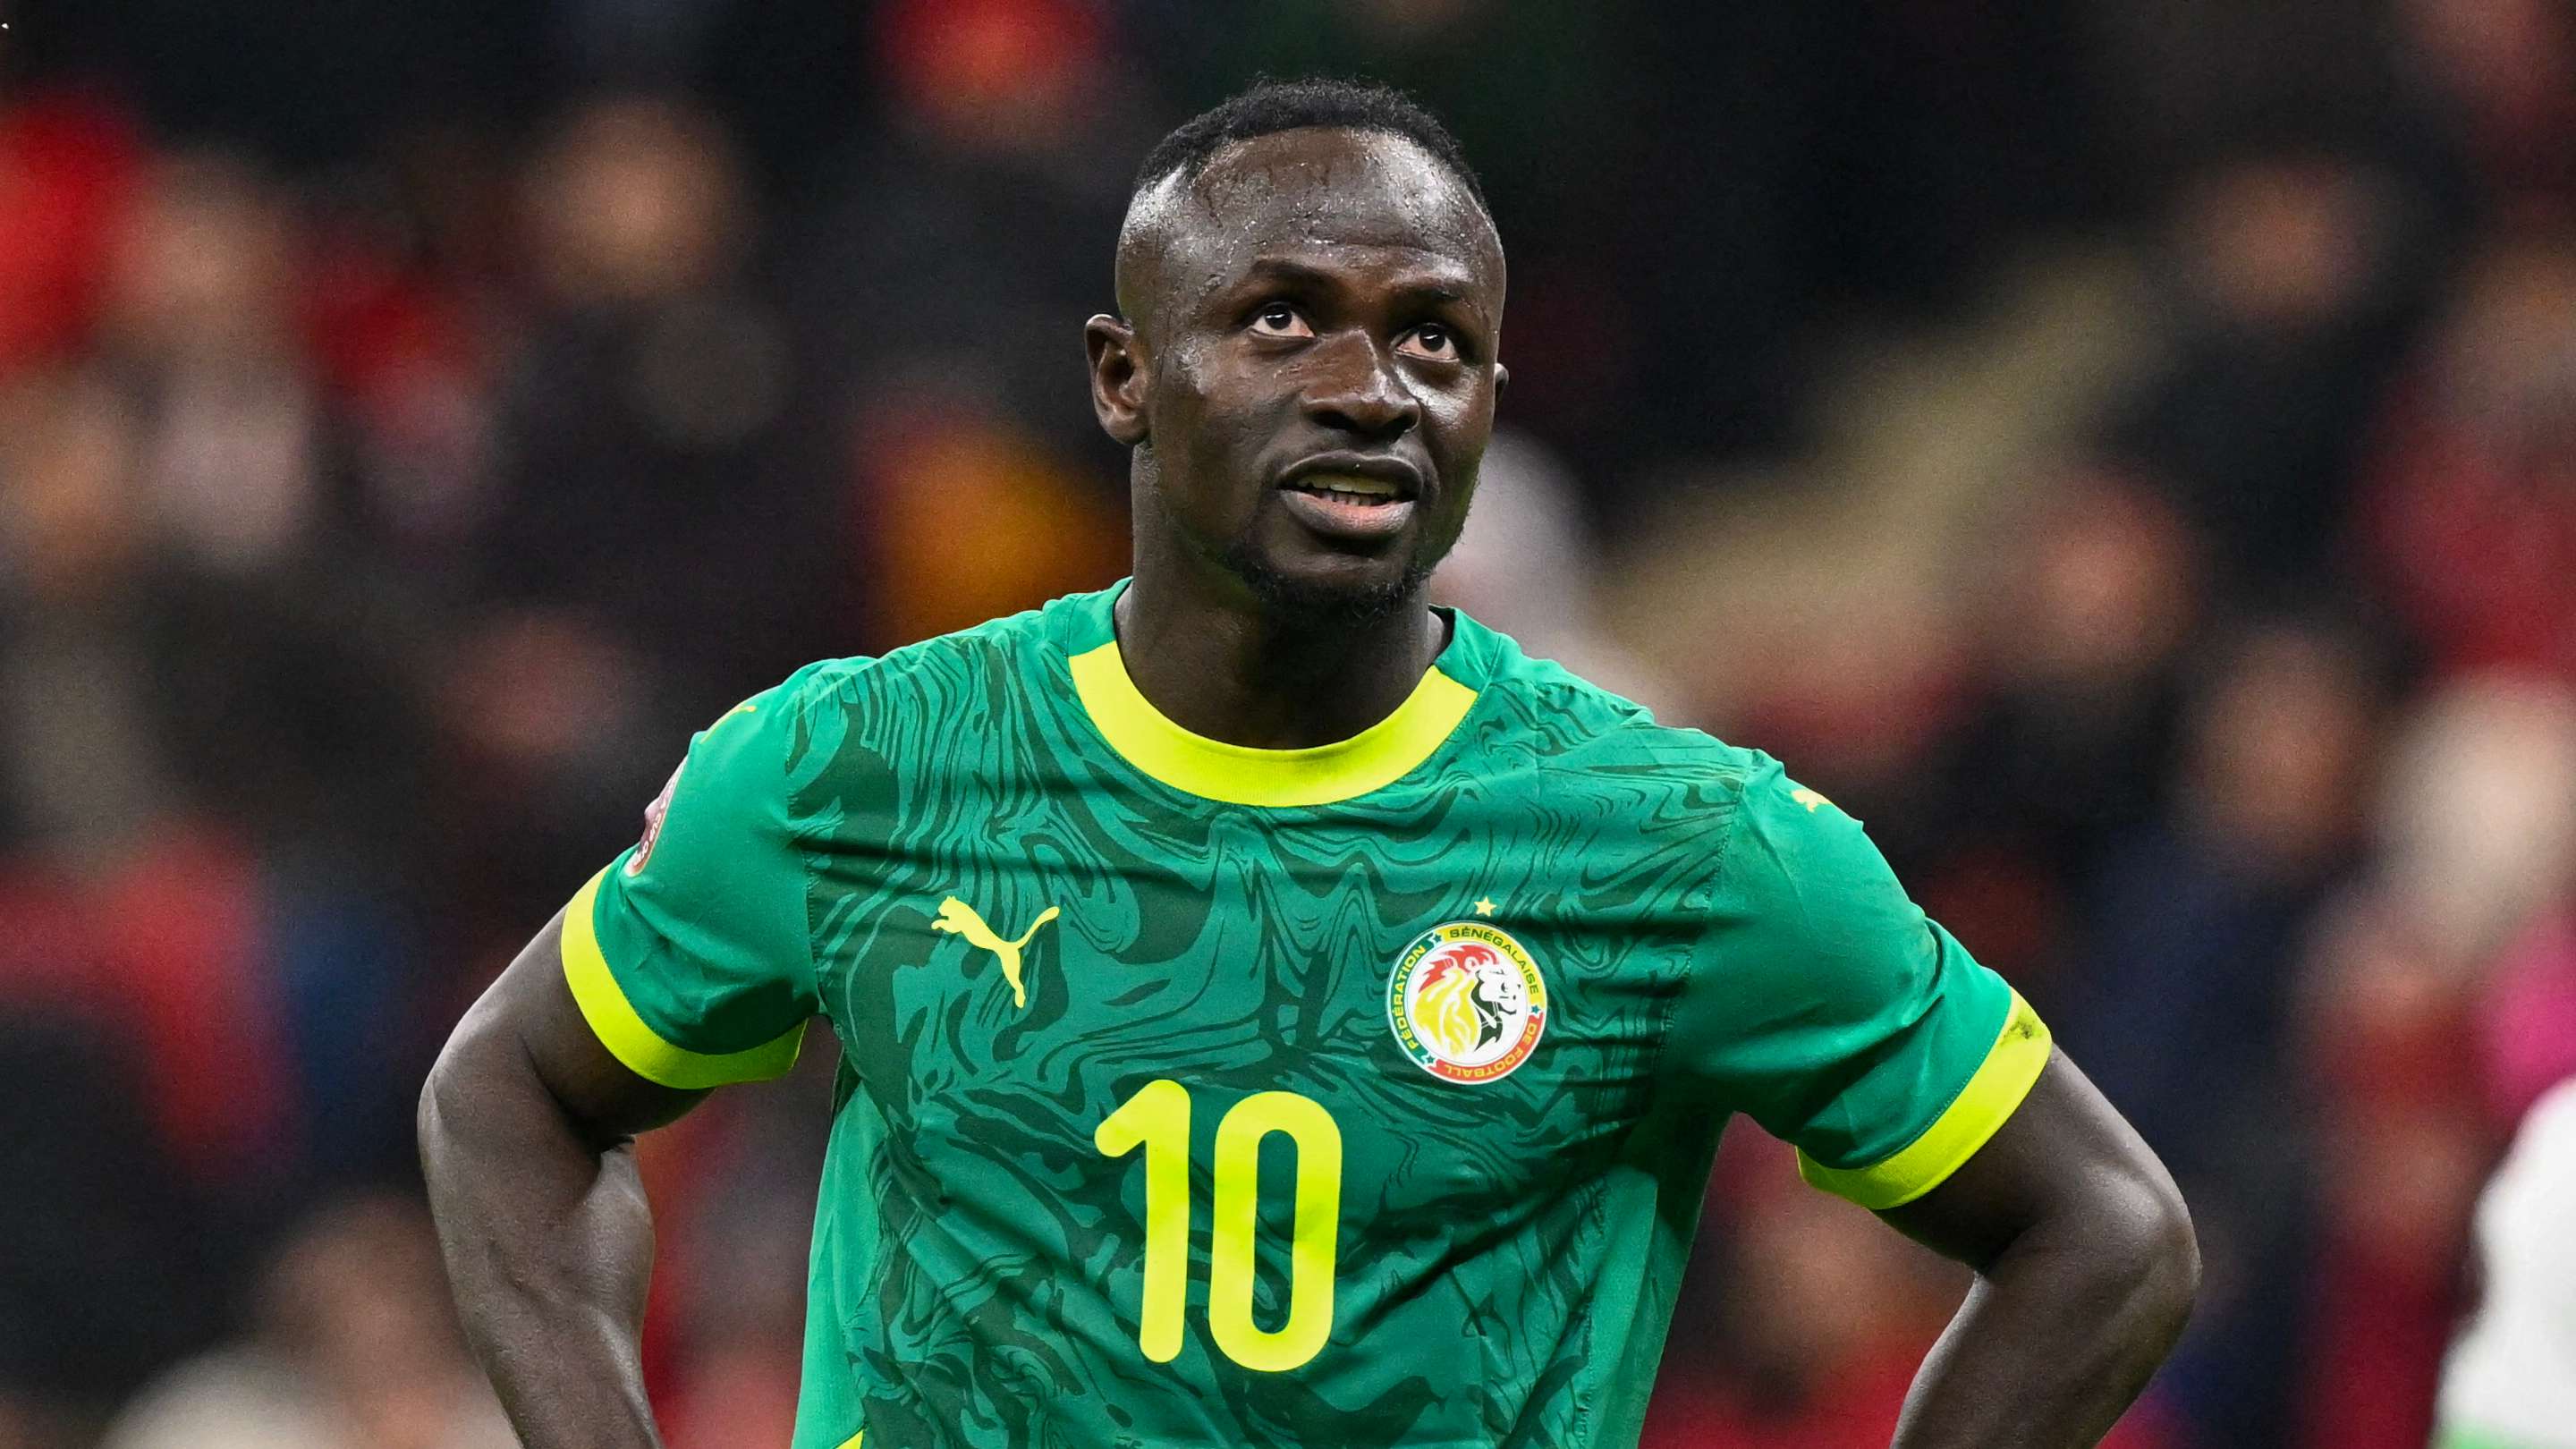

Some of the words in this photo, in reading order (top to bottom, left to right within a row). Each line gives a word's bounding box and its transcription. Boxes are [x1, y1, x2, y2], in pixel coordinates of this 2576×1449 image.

[1449, 927, 1539, 995] SÉNÉGALAISE
[1392, 945, 1427, 1049] FÉDÉRATION
[1445, 1047, 1524, 1078] FOOTBALL
[1521, 1022, 1537, 1046] DE
[1094, 1079, 1343, 1372] 10
